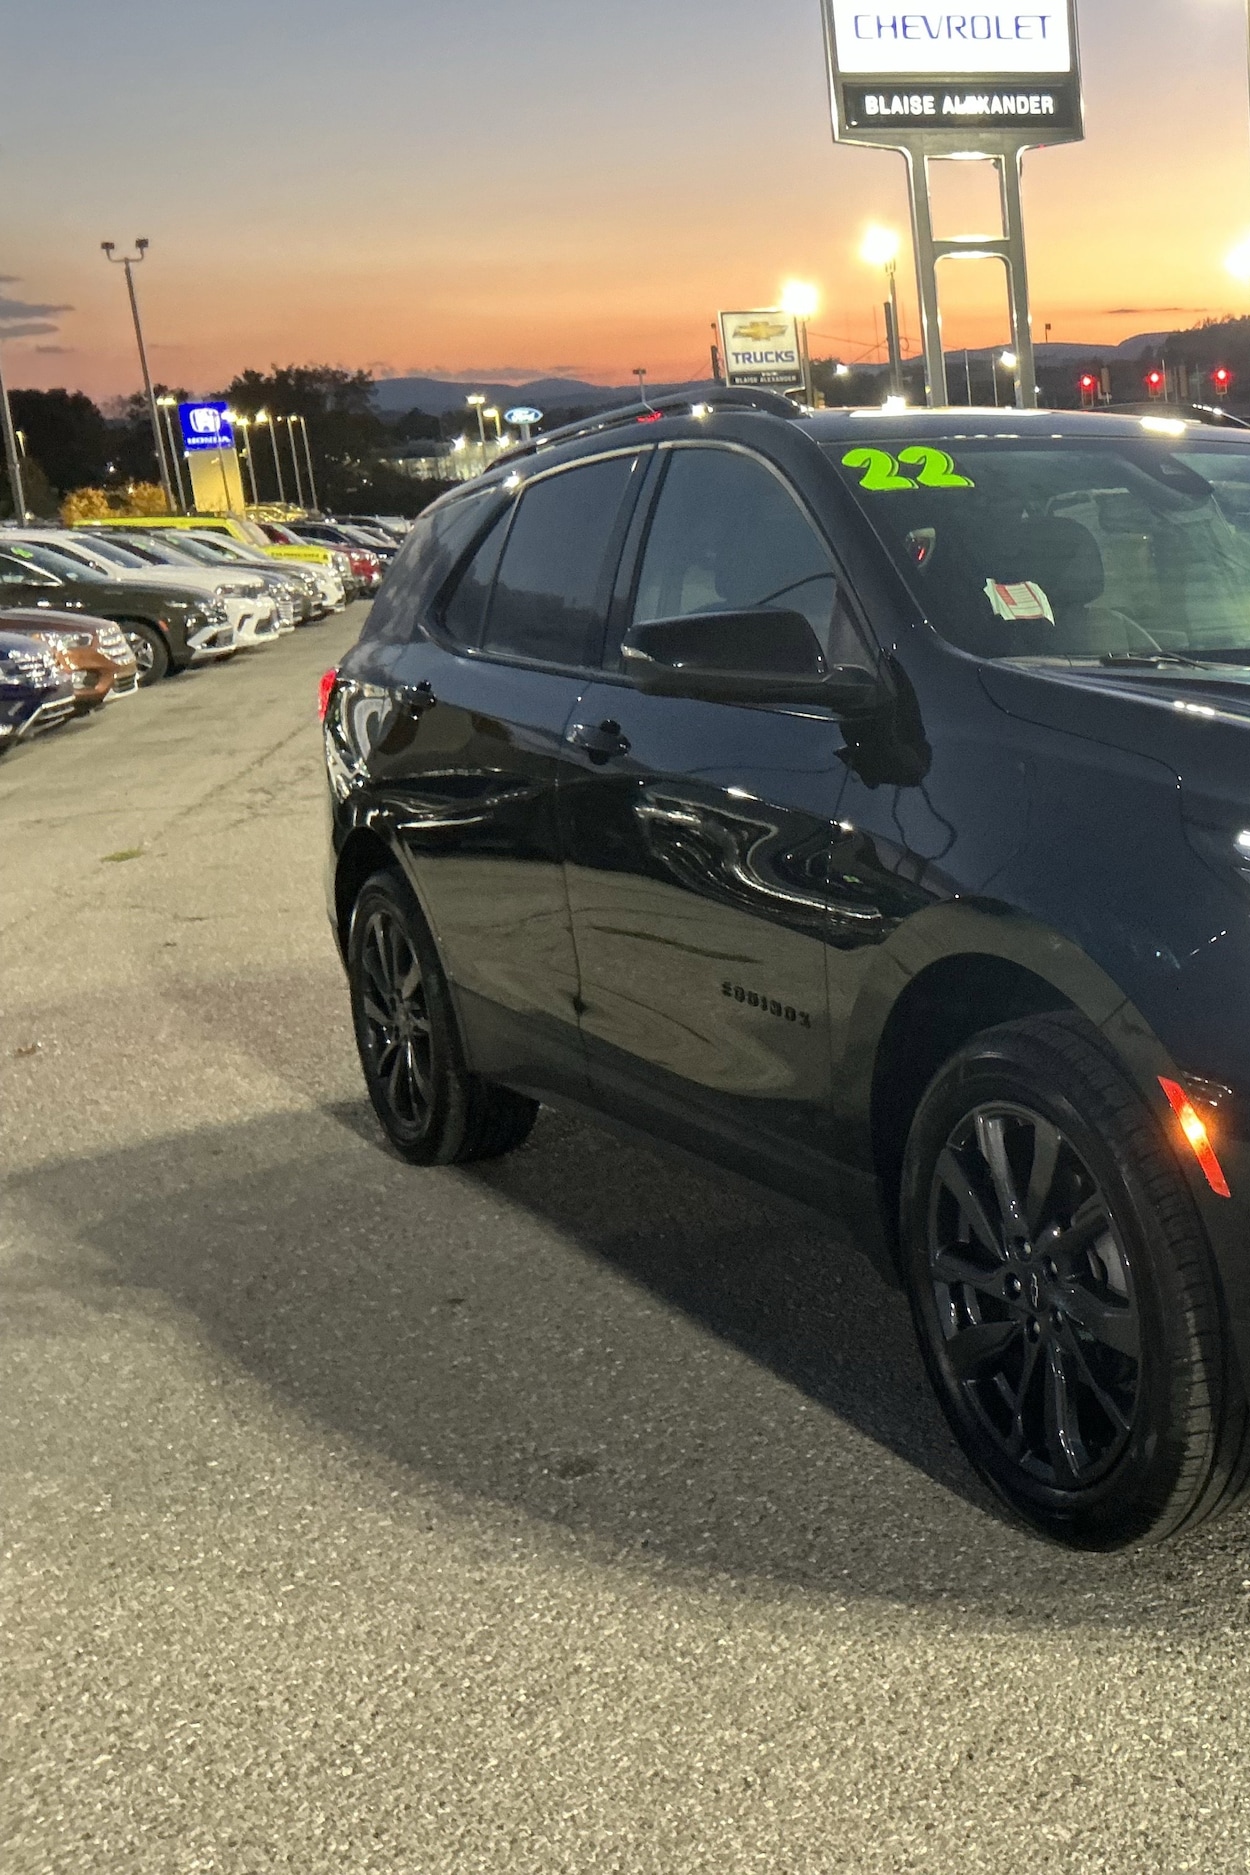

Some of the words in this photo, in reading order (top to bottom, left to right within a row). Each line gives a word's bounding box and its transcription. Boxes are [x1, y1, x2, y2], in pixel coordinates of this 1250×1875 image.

[853, 15, 1052, 40] CHEVROLET
[864, 95, 936, 115] BLAISE
[732, 351, 795, 364] TRUCKS
[842, 446, 975, 491] 22
[721, 981, 811, 1029] EQUINOX
